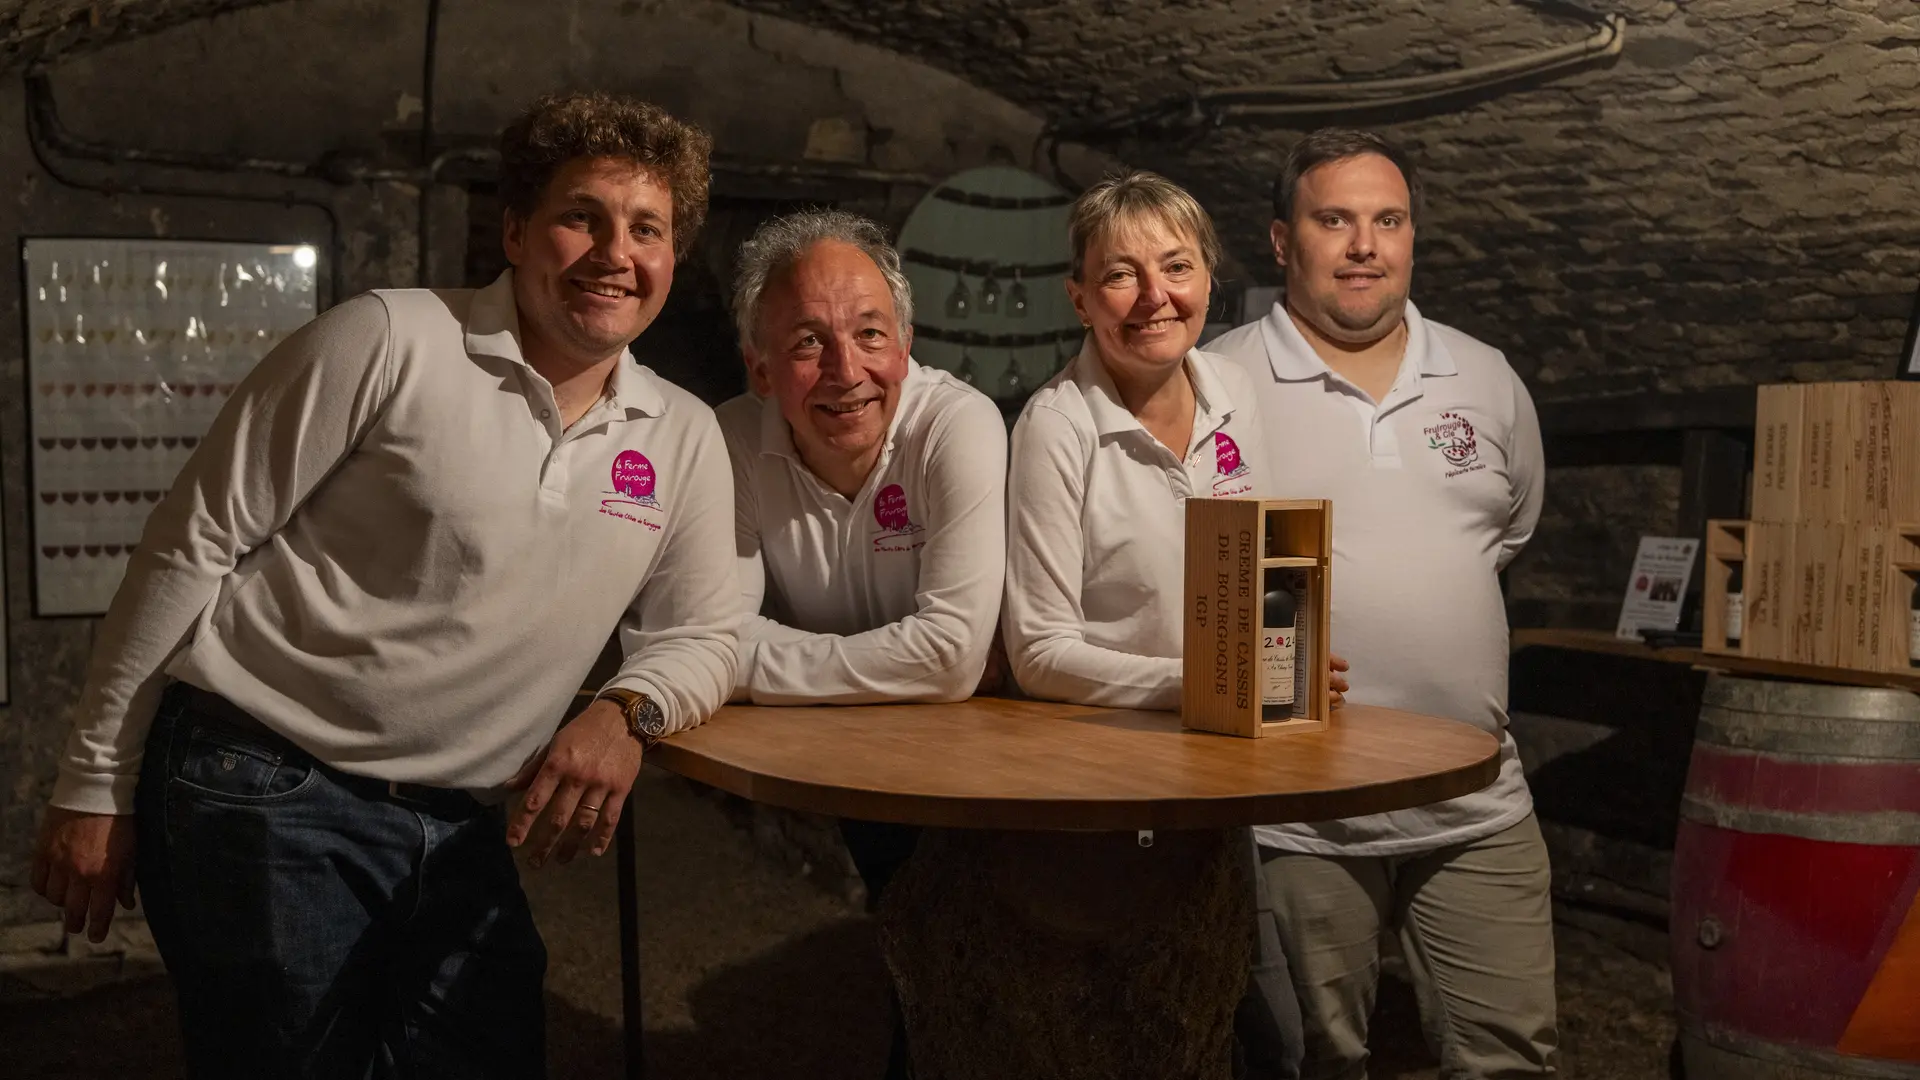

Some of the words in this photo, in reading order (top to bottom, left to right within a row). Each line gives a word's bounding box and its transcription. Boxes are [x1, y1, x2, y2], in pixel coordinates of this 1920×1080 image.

[1216, 440, 1230, 450] erme
[1435, 432, 1441, 440] &
[624, 459, 649, 470] Ferme
[615, 471, 651, 486] Fruirouge
[1218, 533, 1230, 561] DE
[1238, 531, 1252, 598] CREME
[1196, 594, 1208, 628] IGP
[1237, 608, 1250, 633] DE
[1216, 572, 1229, 696] BOURGOGNE
[1236, 642, 1249, 710] CASSIS
